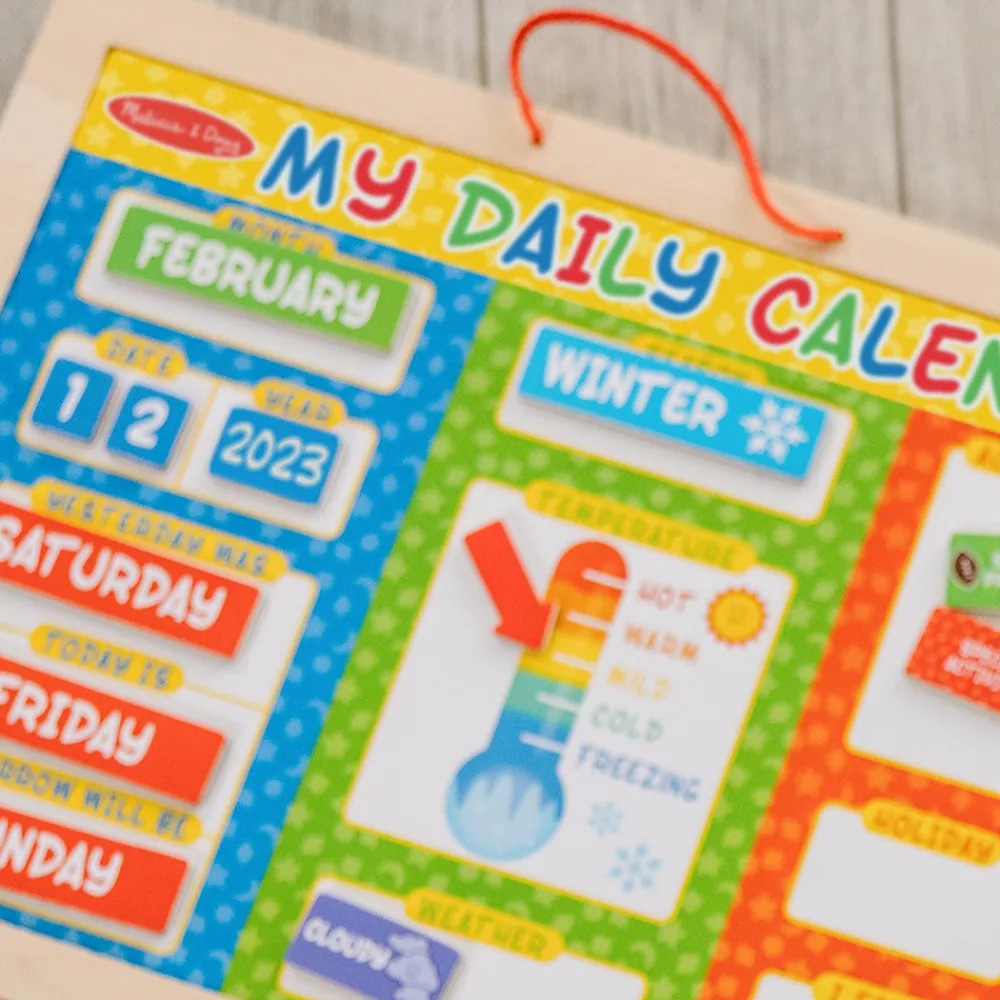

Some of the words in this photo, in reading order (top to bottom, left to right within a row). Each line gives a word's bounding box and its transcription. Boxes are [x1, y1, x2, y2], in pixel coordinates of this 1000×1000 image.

[258, 124, 417, 222] MY
[446, 181, 719, 314] DAILY
[136, 225, 381, 328] FEBRUARY
[108, 338, 172, 375] DATE
[57, 371, 89, 424] 1
[125, 396, 171, 449] 2
[542, 341, 729, 438] WINTER
[220, 421, 331, 487] 2023
[48, 486, 206, 552] YESTERDAY
[0, 513, 228, 633] SATURDAY
[638, 581, 697, 614] HOT
[45, 630, 131, 678] TODAY
[139, 661, 172, 689] IS
[624, 624, 701, 665] WARM
[606, 666, 674, 702] MILD
[0, 670, 156, 767] FRIDAY
[589, 703, 666, 743] COLD
[577, 743, 702, 802] FREEZING
[873, 809, 997, 865] HOLIDAY
[418, 900, 549, 959] WEATHER
